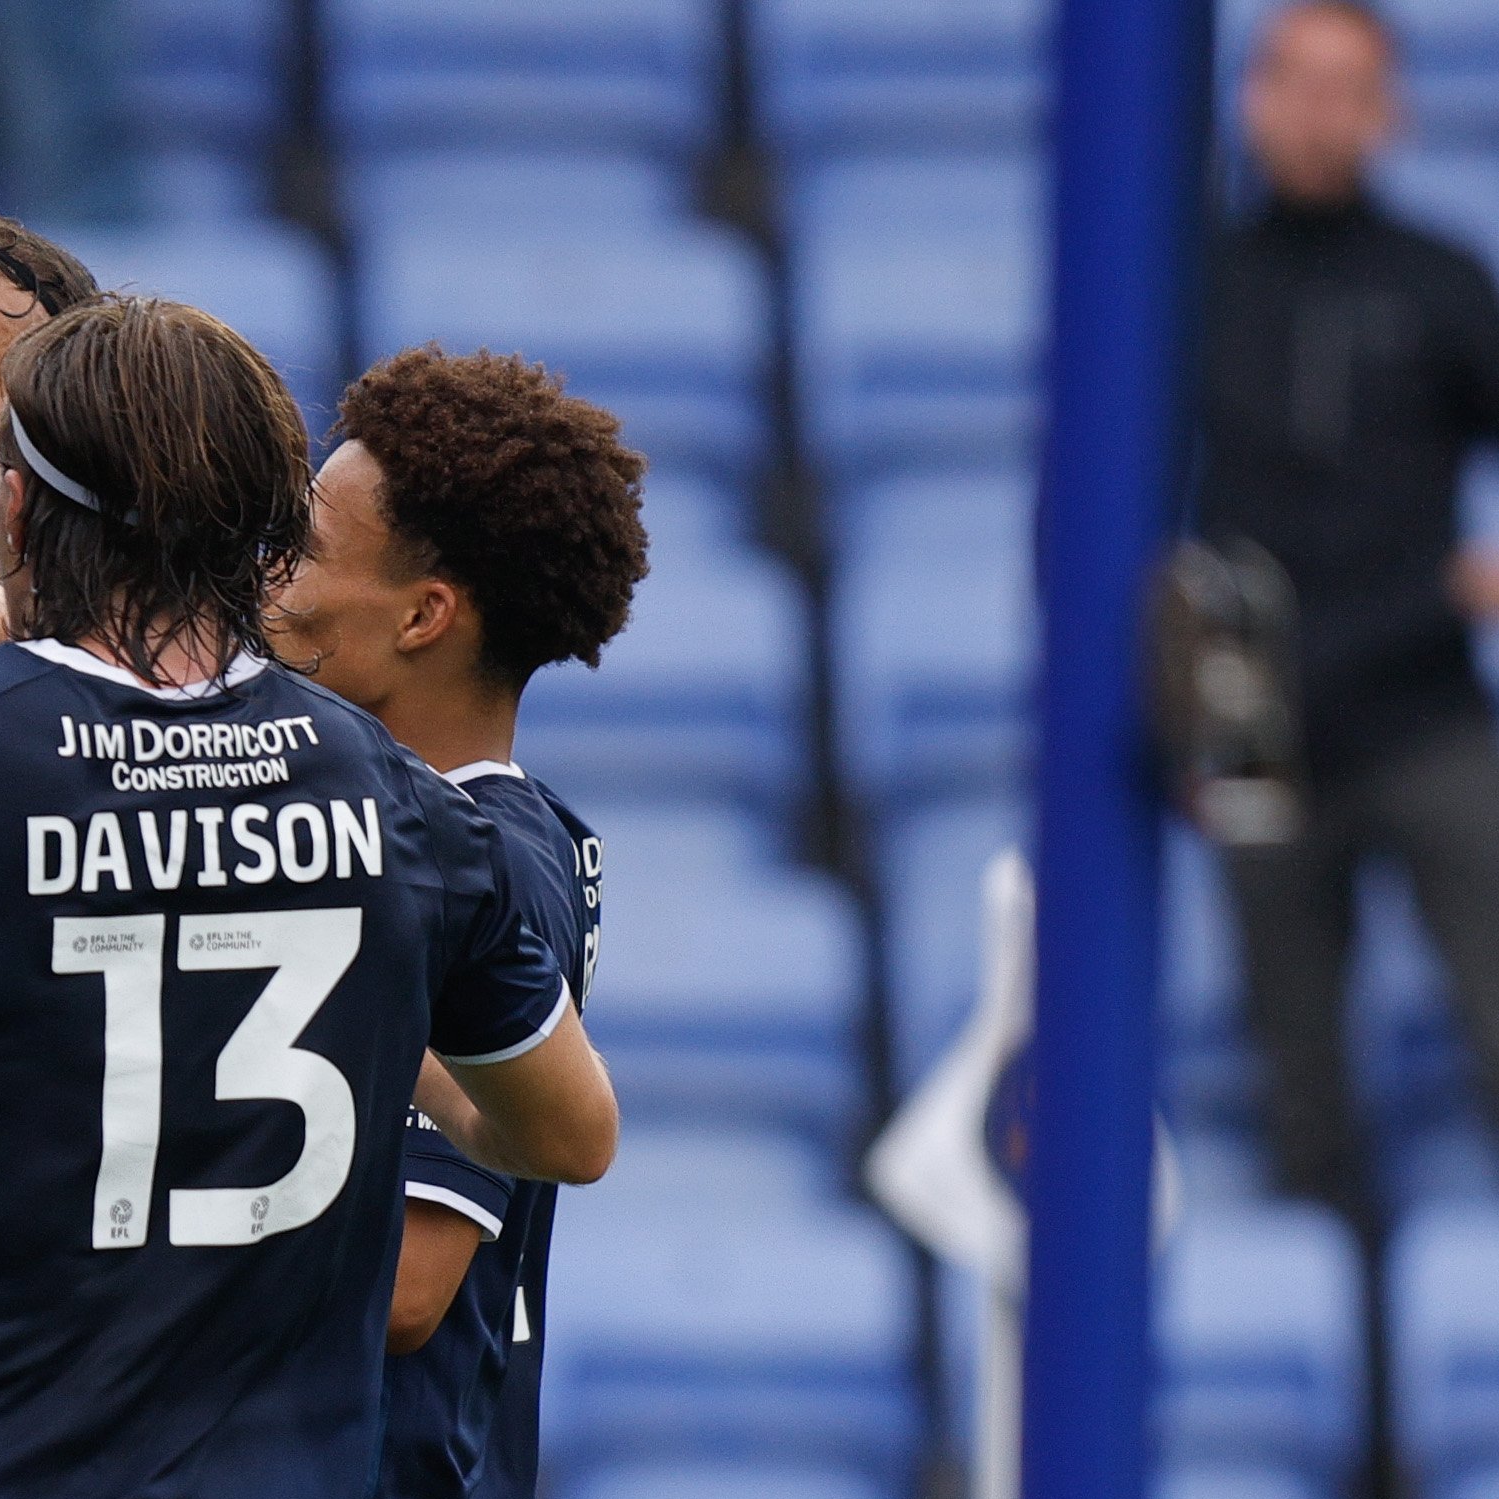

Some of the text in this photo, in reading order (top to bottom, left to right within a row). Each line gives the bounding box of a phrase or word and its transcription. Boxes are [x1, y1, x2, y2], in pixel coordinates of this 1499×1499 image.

[57, 716, 320, 762] JIM DORRICOTT
[112, 757, 290, 792] CONSTRUCTION
[26, 797, 383, 896] DAVISON
[52, 907, 363, 1249] 13
